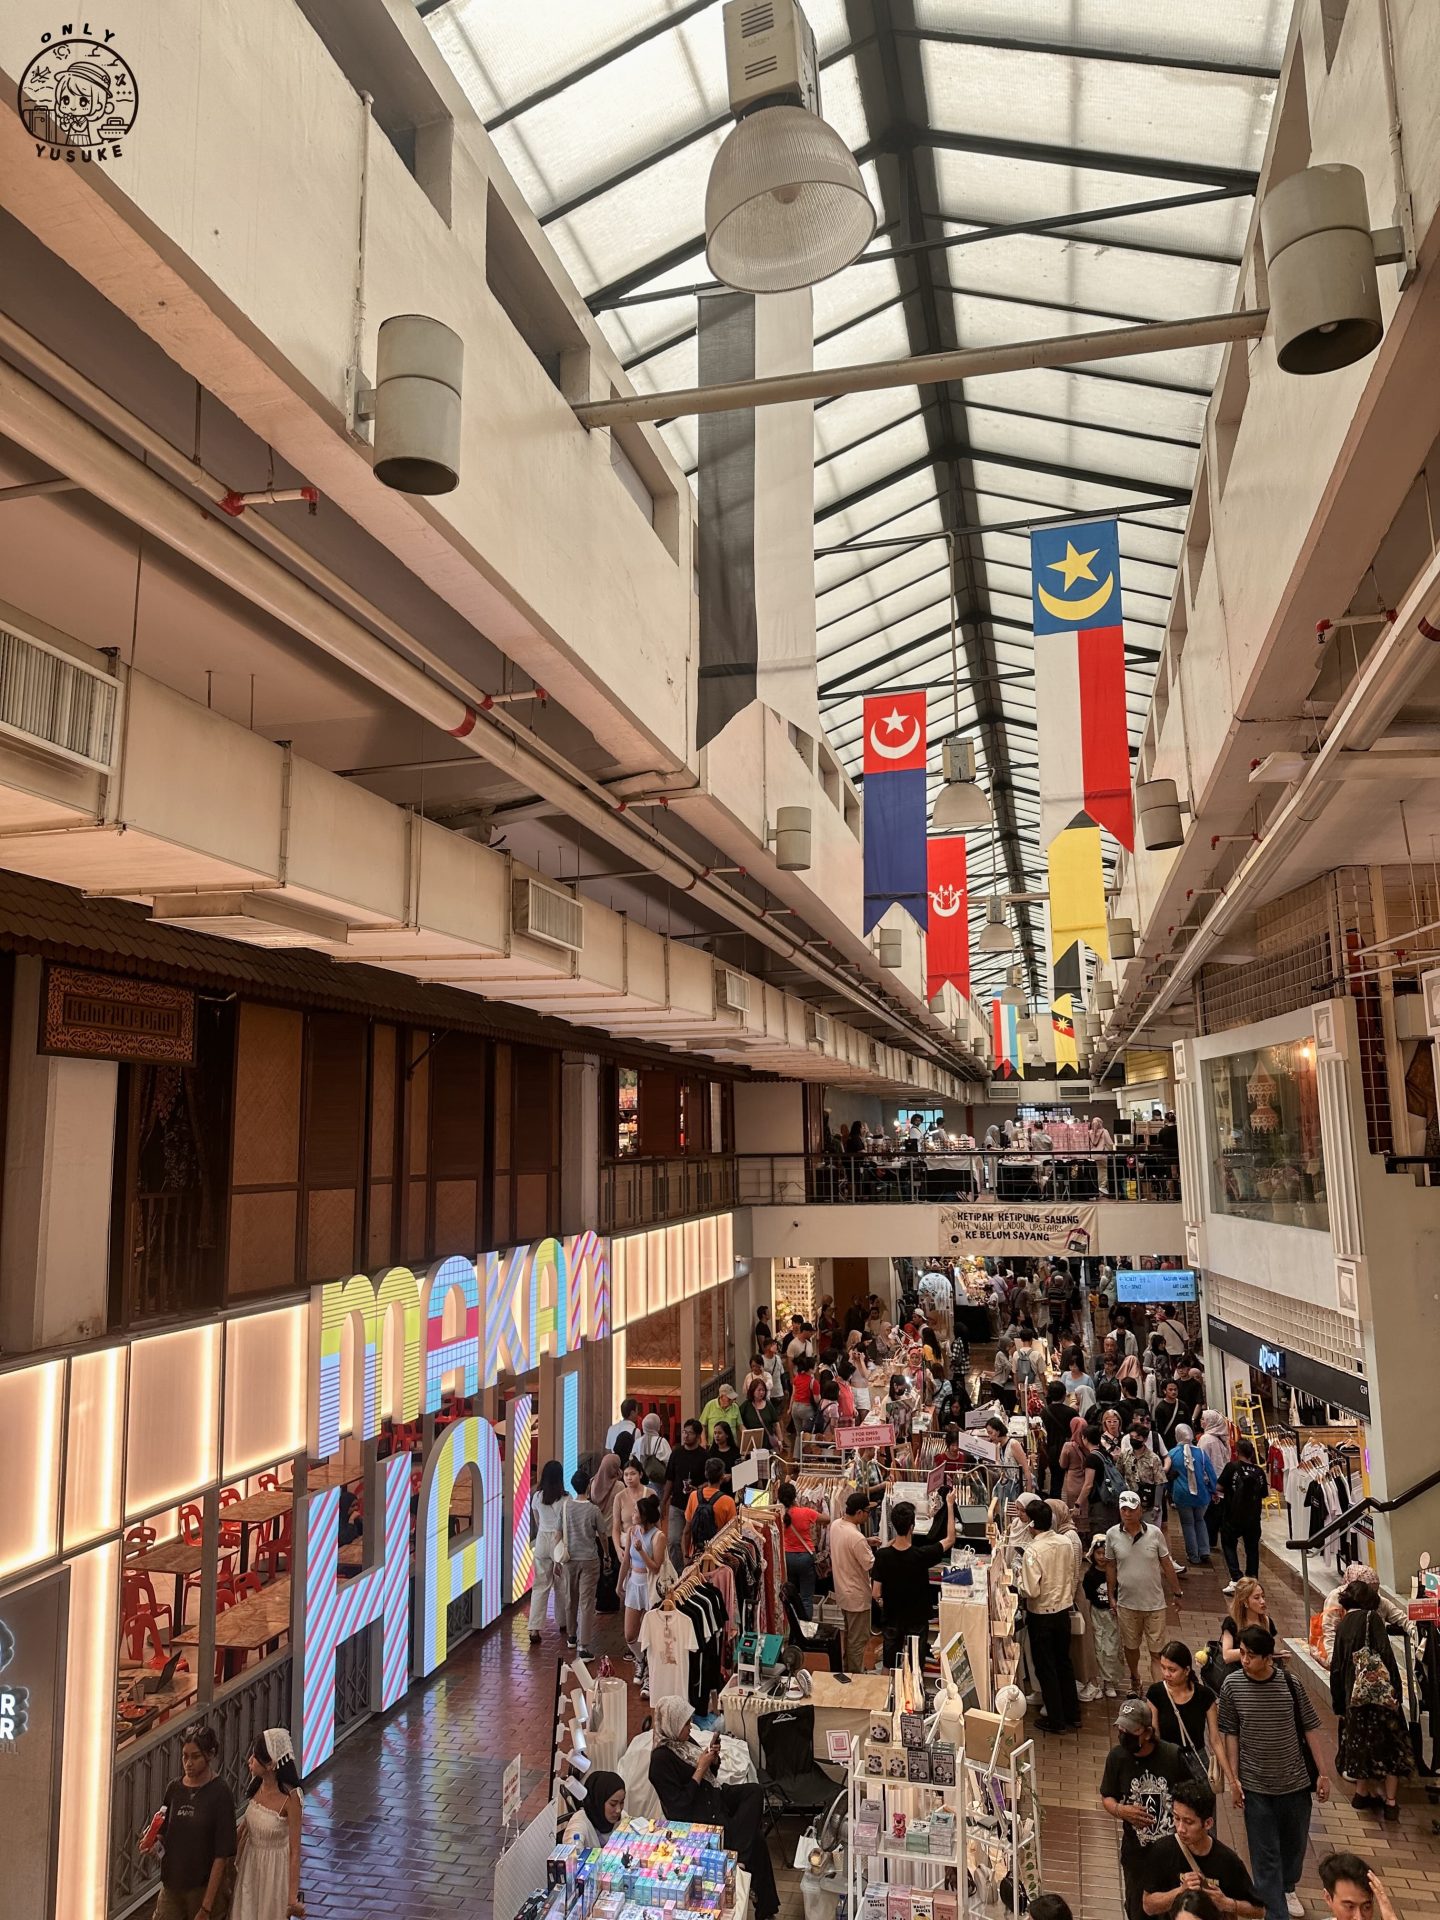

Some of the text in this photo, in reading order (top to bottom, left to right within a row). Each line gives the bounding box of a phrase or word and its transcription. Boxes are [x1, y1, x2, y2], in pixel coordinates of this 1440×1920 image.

[1045, 1215, 1079, 1224] SAYANG
[998, 1222, 1025, 1230] VENDOR
[1029, 1223, 1063, 1232] UPSTAIRS
[965, 1231, 1050, 1241] KE BELUM SAYANG
